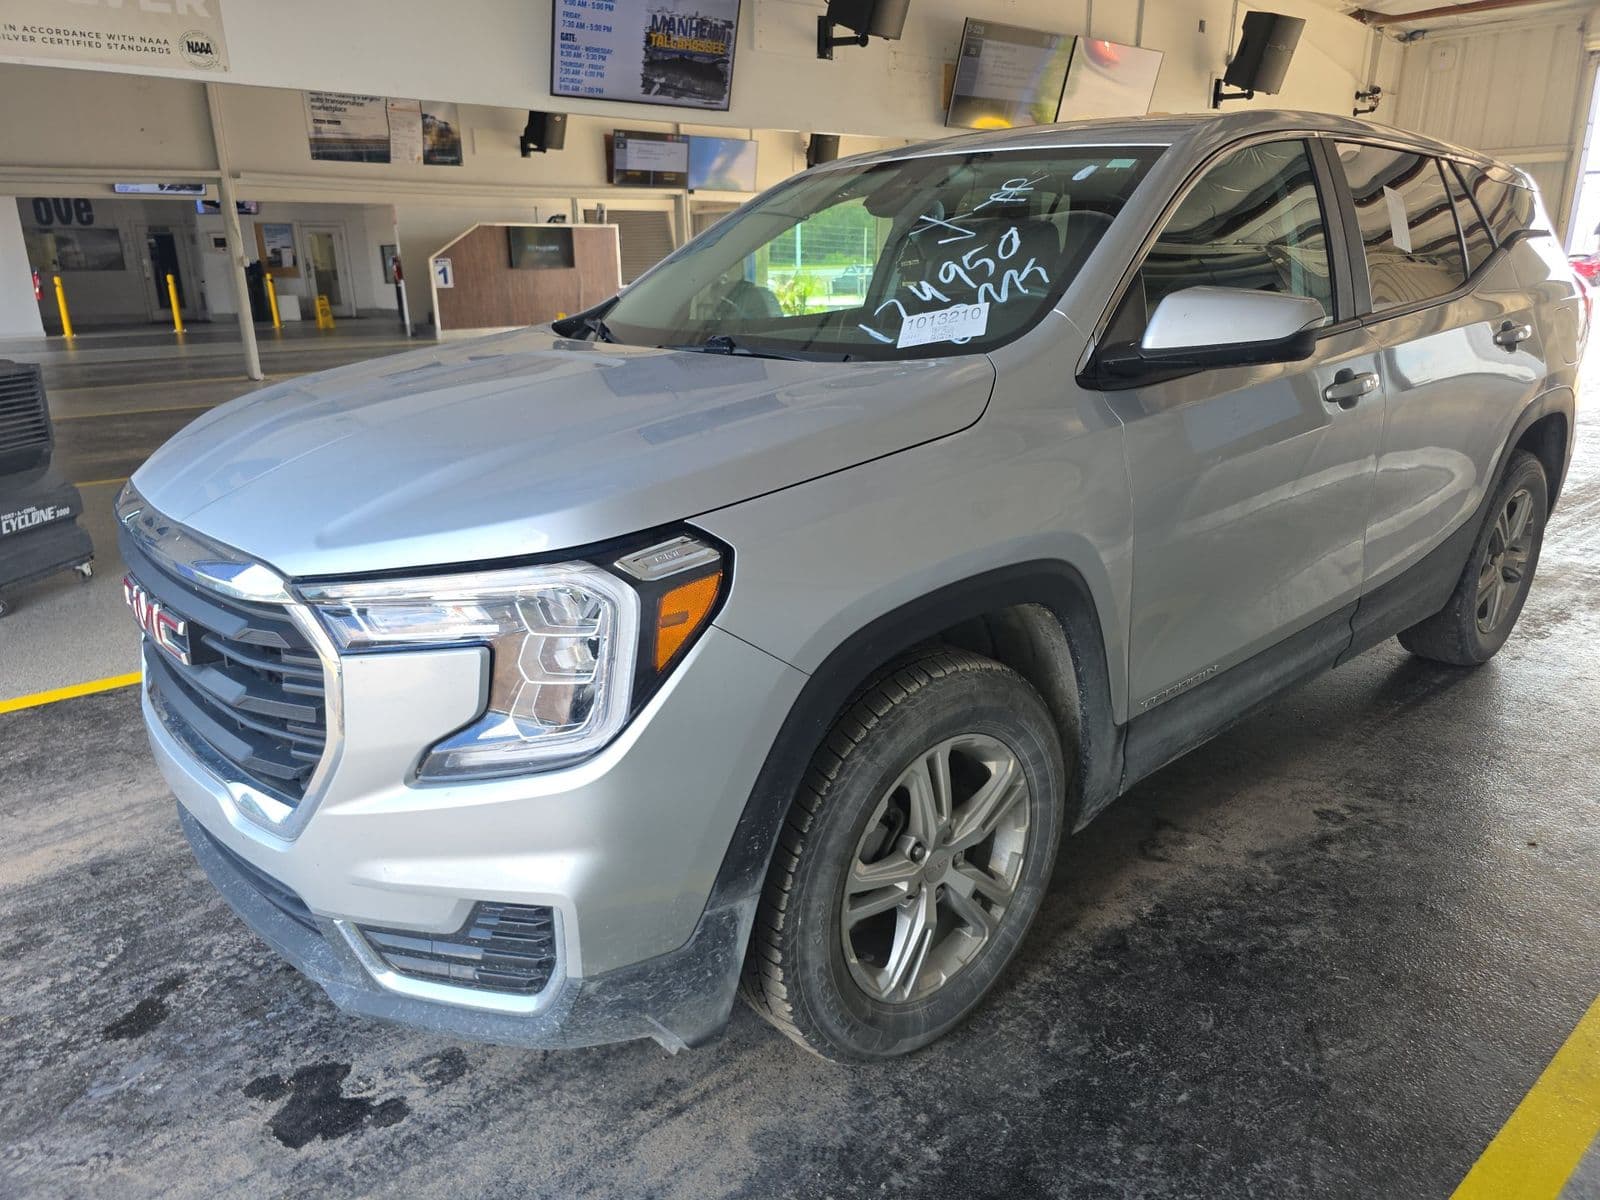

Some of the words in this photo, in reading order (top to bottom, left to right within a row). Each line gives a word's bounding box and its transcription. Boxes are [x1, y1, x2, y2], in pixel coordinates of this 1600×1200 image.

[3, 23, 17, 32] IN
[22, 25, 102, 40] ACCORDANCE
[106, 32, 135, 43] WITH
[140, 36, 170, 46] NAAA
[652, 13, 728, 42] MANHEIM
[0, 32, 36, 43] ILVER
[41, 36, 102, 49] CERTIFIED
[107, 42, 172, 55] STANDARDS
[186, 40, 214, 55] NAAA
[438, 266, 449, 285] 1
[907, 306, 983, 331] 1013210
[1, 507, 55, 535] CYCLONE
[122, 575, 190, 667] GMC
